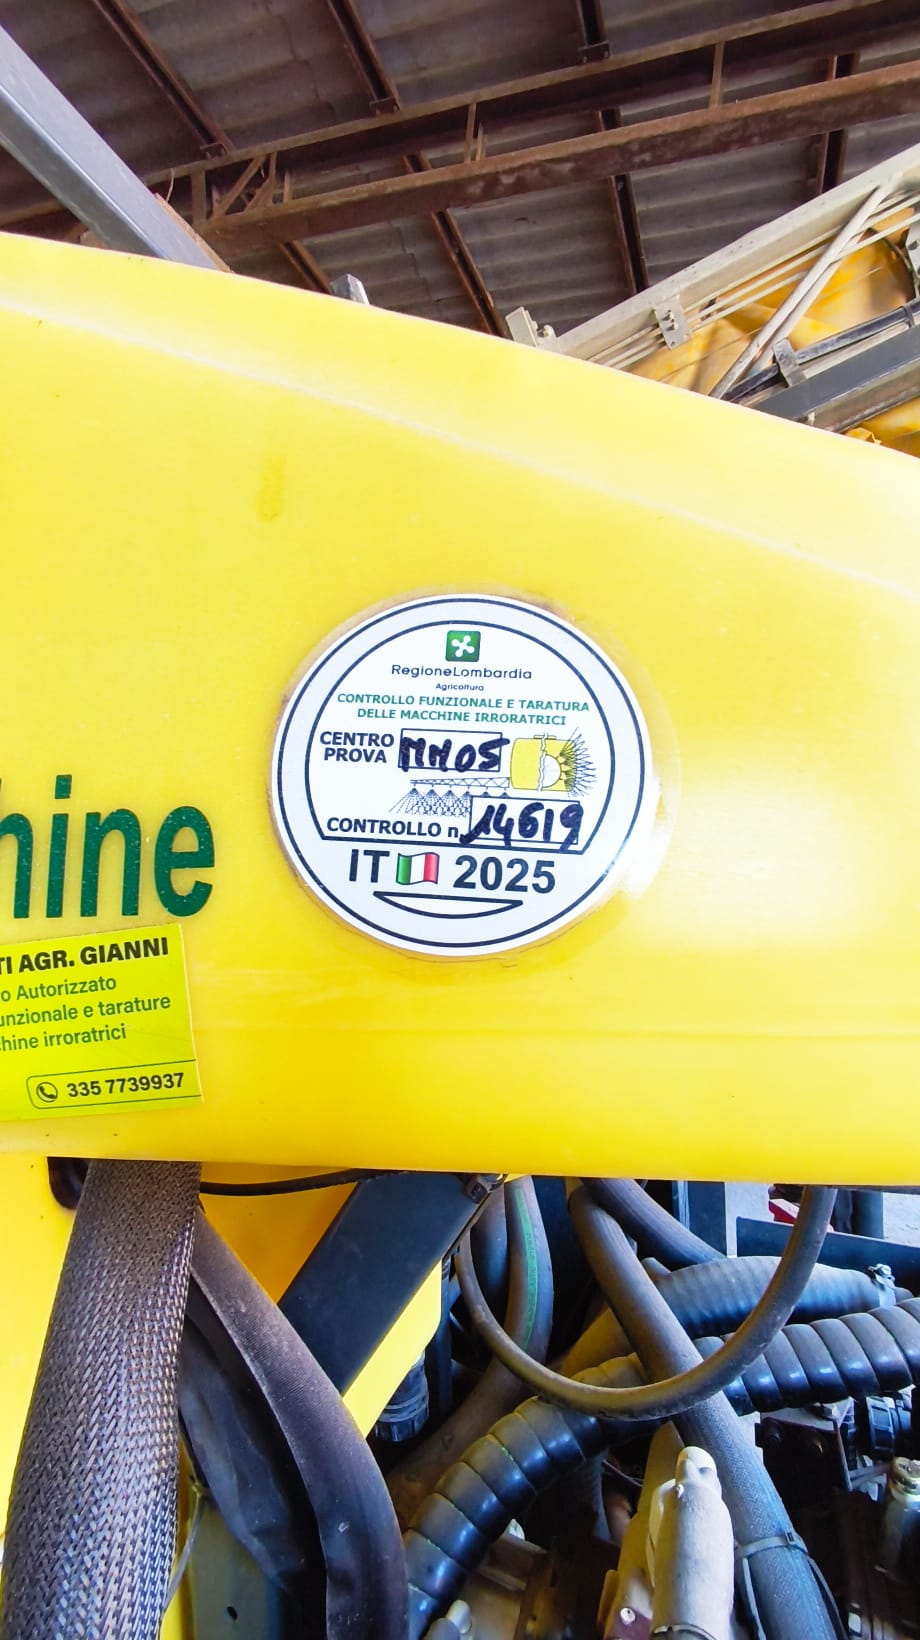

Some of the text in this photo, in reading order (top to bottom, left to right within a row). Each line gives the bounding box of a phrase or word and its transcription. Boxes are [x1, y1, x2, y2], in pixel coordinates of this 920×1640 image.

[391, 664, 532, 680] RegioneLombardia
[436, 683, 484, 692] Agricoltura
[337, 693, 590, 712] CONTROLLO FUNZIONALE E TARATURA
[357, 708, 566, 726] DELLE MACCHINE IRRORATRICI
[320, 731, 395, 748] CENTRO
[324, 747, 387, 764] PROVA
[326, 817, 442, 838] CONTROLLO
[349, 848, 556, 894] IT 2025
[19, 950, 75, 973] AGR.
[80, 937, 169, 966] GIANNI
[16, 976, 117, 1001] Autorizzato
[83, 1005, 94, 1018] e
[98, 996, 171, 1017] tarature
[0, 1023, 127, 1051] hine irroratrici
[66, 1072, 184, 1098] 335 7739937
